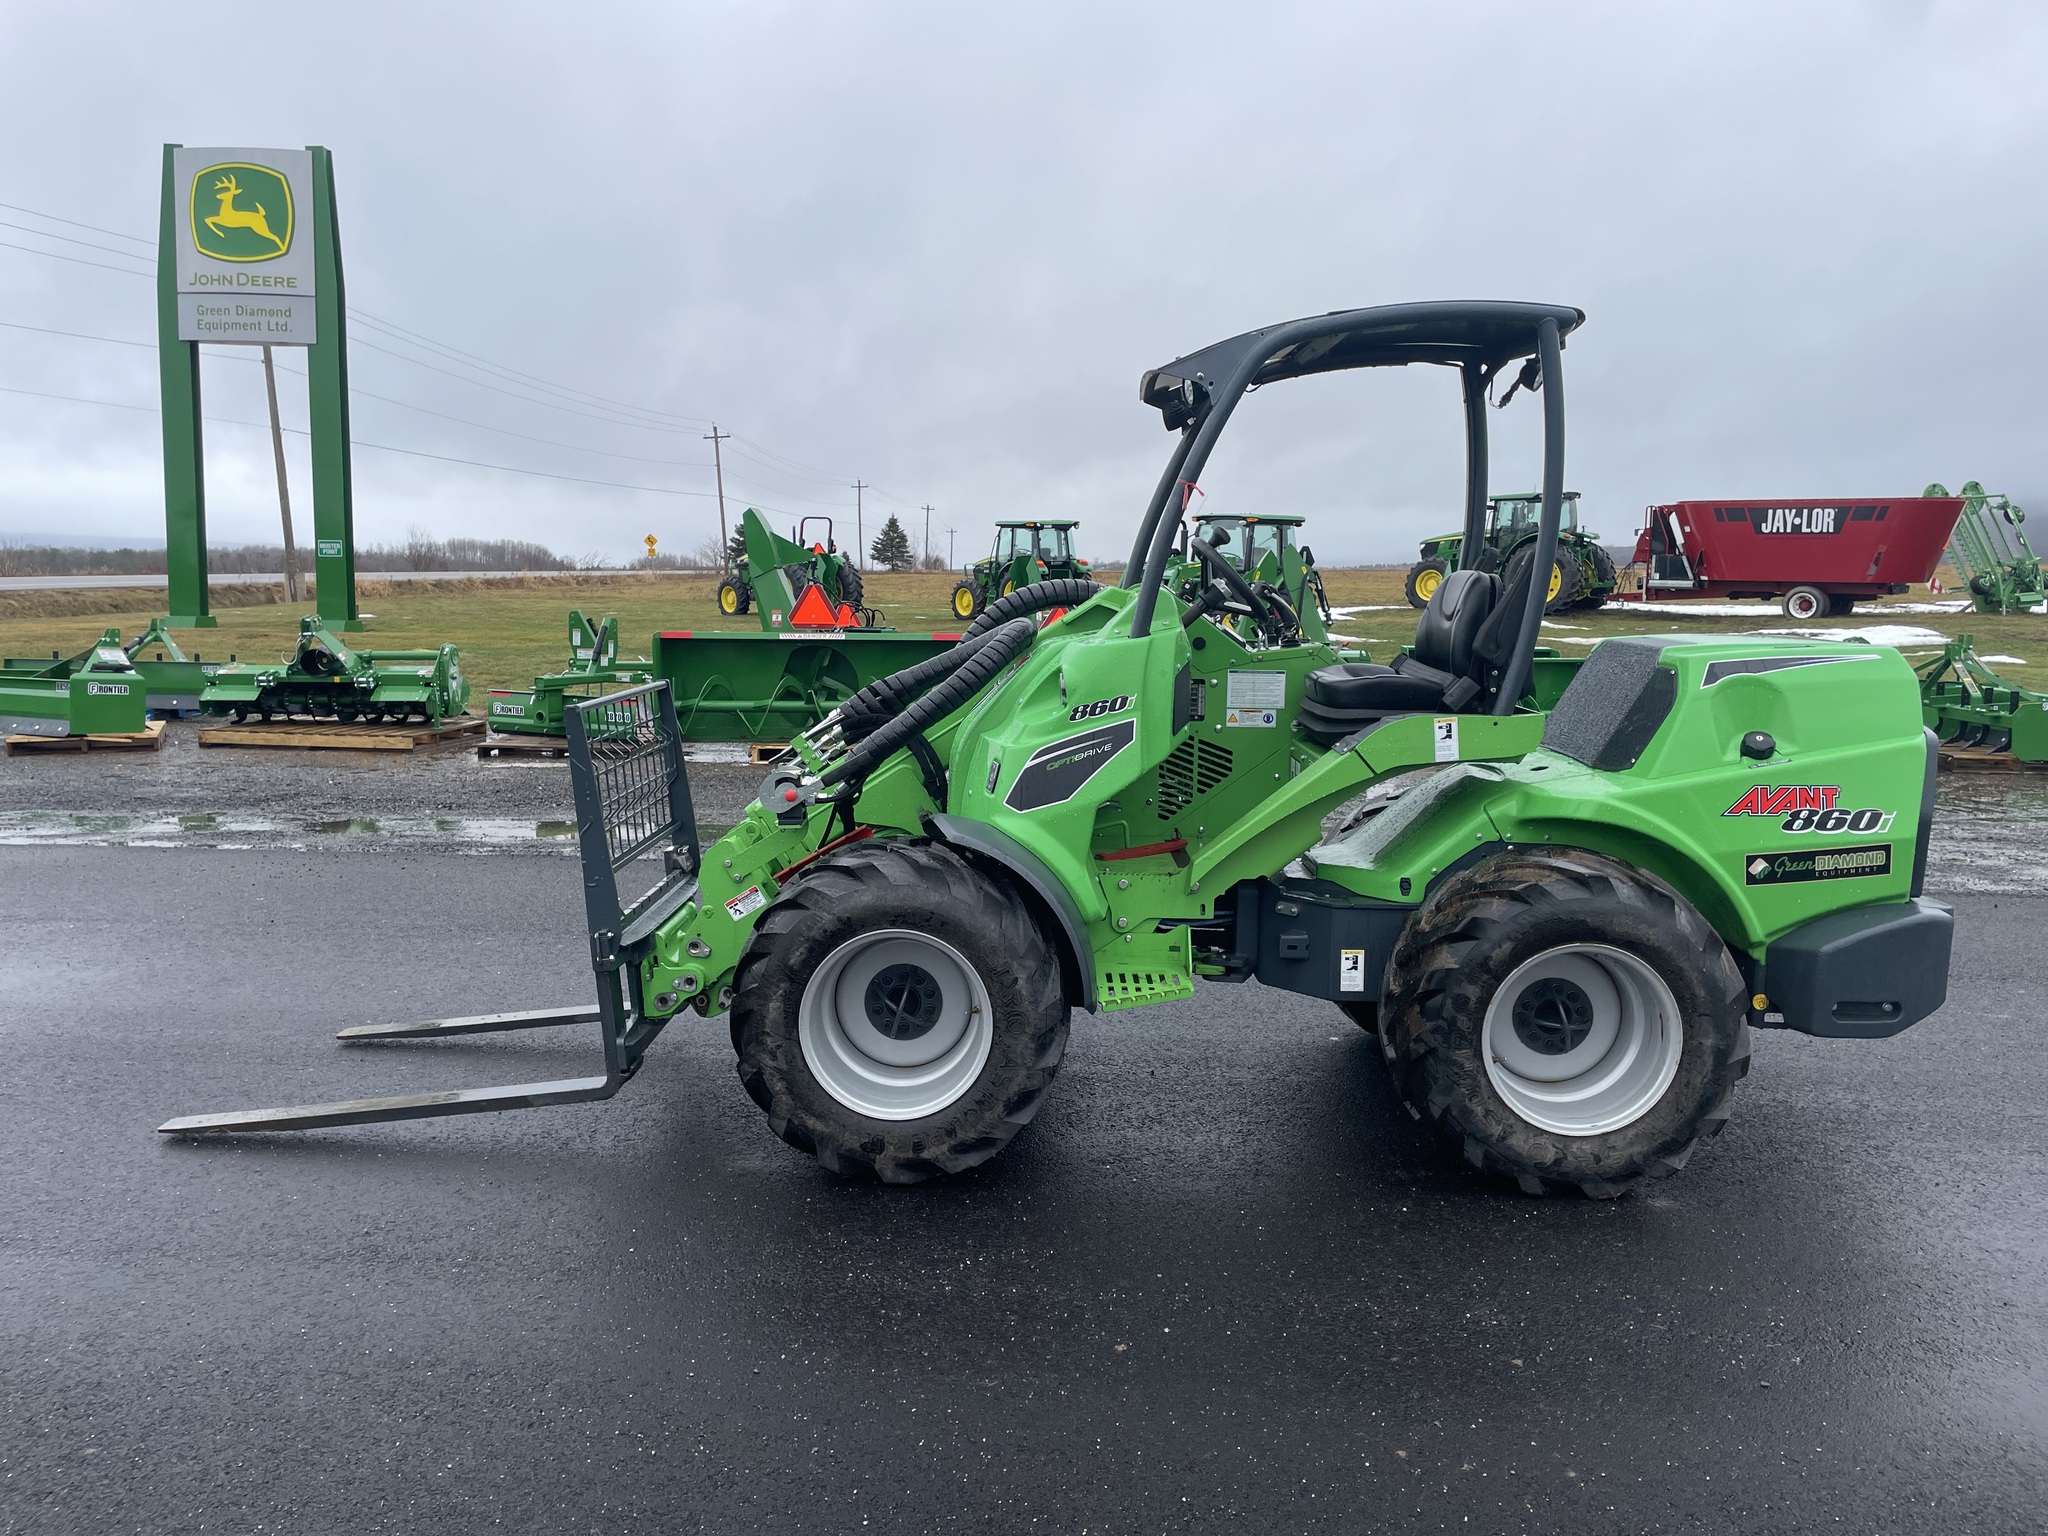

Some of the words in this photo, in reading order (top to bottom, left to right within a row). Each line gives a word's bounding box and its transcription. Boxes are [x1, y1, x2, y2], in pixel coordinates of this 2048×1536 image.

[189, 272, 233, 286] JOHN
[236, 273, 297, 288] DEERE
[196, 304, 231, 316] Green
[235, 305, 292, 318] Diamond
[197, 319, 262, 333] Equipment
[267, 320, 293, 332] Ltd.
[89, 682, 129, 695] FRONTIER
[493, 702, 524, 716] FRONTIER
[1720, 785, 1841, 817] AVANT
[1774, 857, 1815, 878] Green
[1815, 851, 1886, 870] DIAMOND
[1815, 866, 1878, 877] EQUIPMENT
